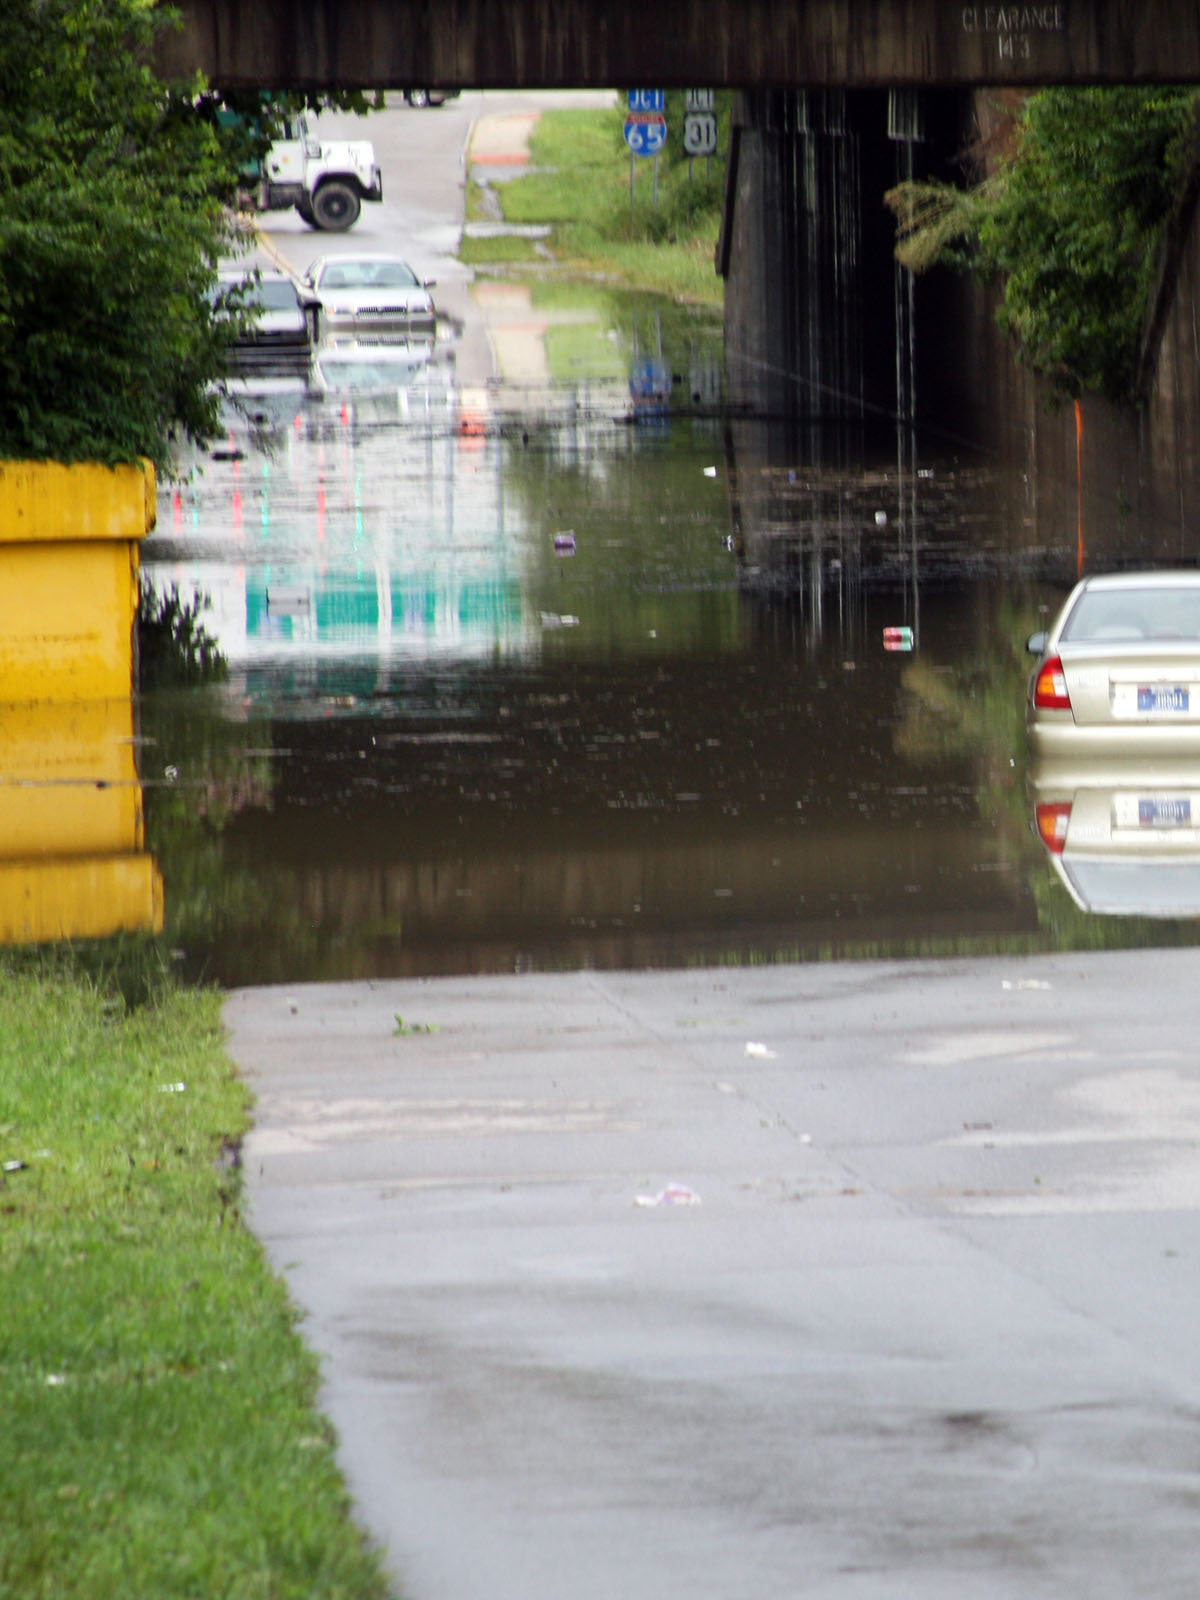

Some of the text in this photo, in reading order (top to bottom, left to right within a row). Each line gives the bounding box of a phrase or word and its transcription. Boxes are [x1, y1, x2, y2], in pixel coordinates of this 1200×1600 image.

[962, 5, 1063, 32] CLEARANCE
[628, 123, 662, 150] 65
[690, 121, 711, 146] 31
